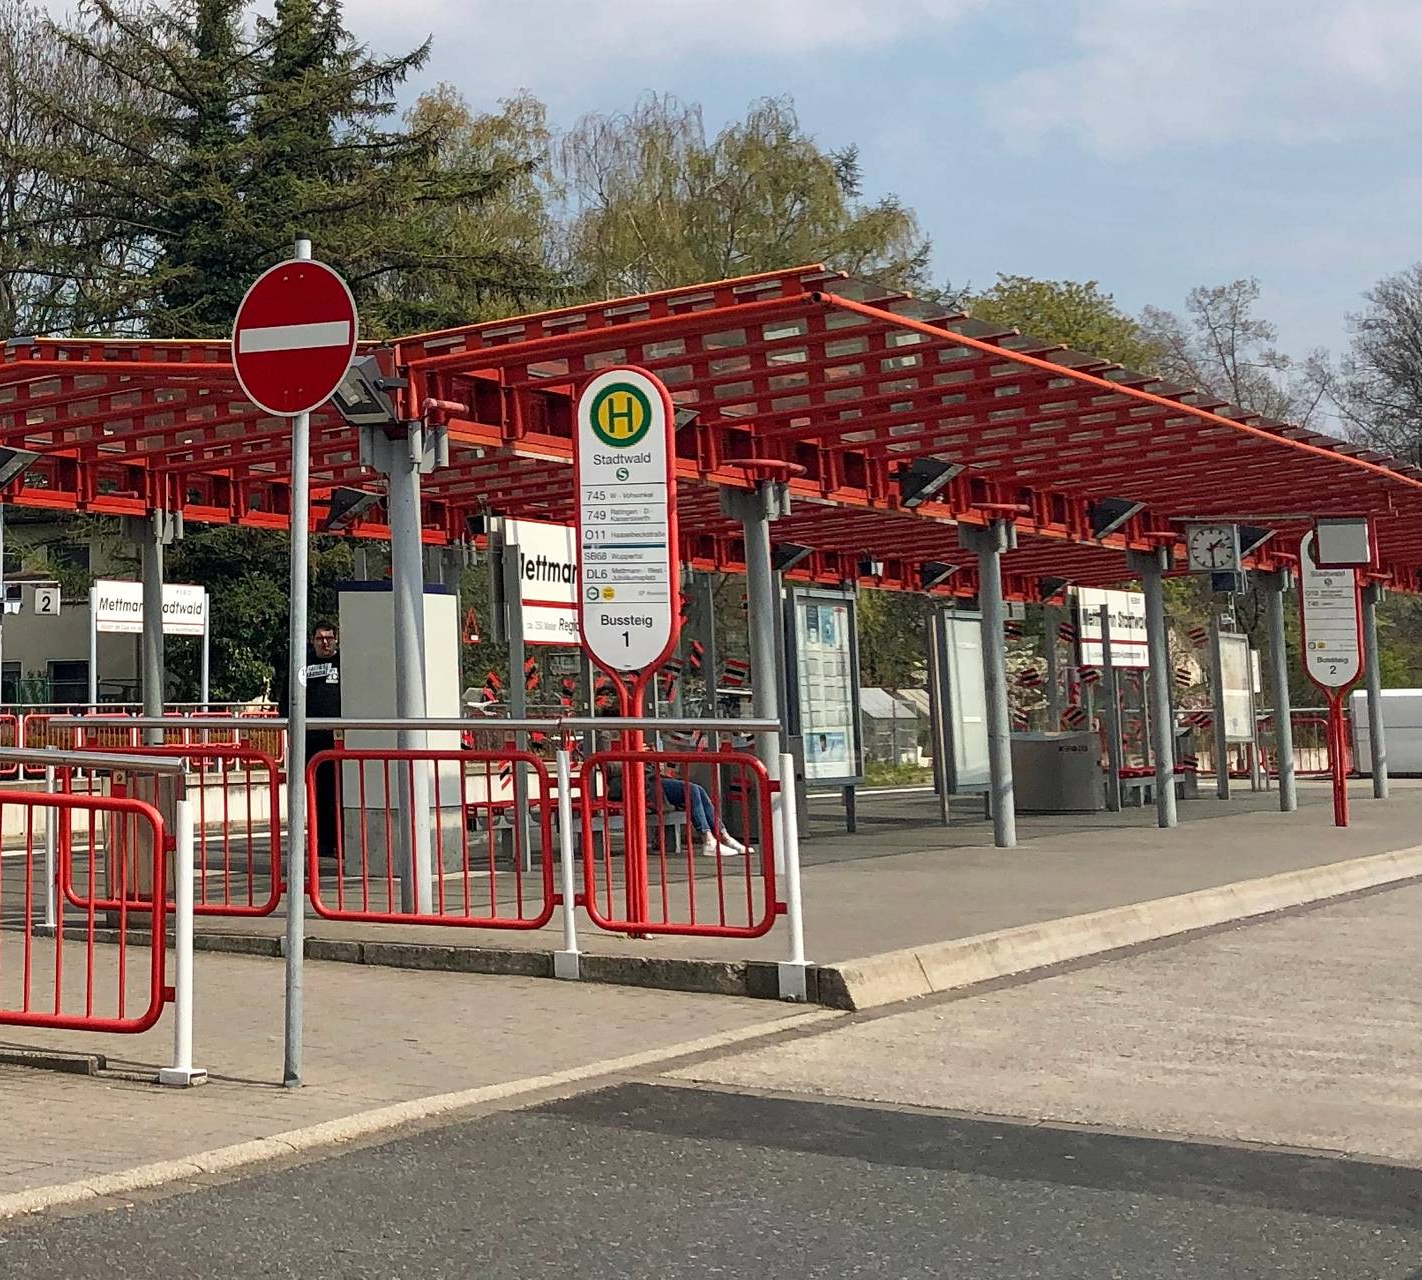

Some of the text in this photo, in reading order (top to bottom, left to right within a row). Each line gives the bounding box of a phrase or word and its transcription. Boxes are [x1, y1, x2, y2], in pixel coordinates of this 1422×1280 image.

[593, 452, 651, 465] Stadtwald
[586, 491, 606, 501] 745
[587, 510, 607, 520] 749
[521, 552, 577, 584] ettma
[586, 569, 608, 579] DL6
[41, 595, 51, 612] 2
[162, 601, 202, 615] adtwald
[600, 614, 653, 628] Bussteig
[622, 630, 629, 648] 1
[1329, 665, 1337, 675] 2
